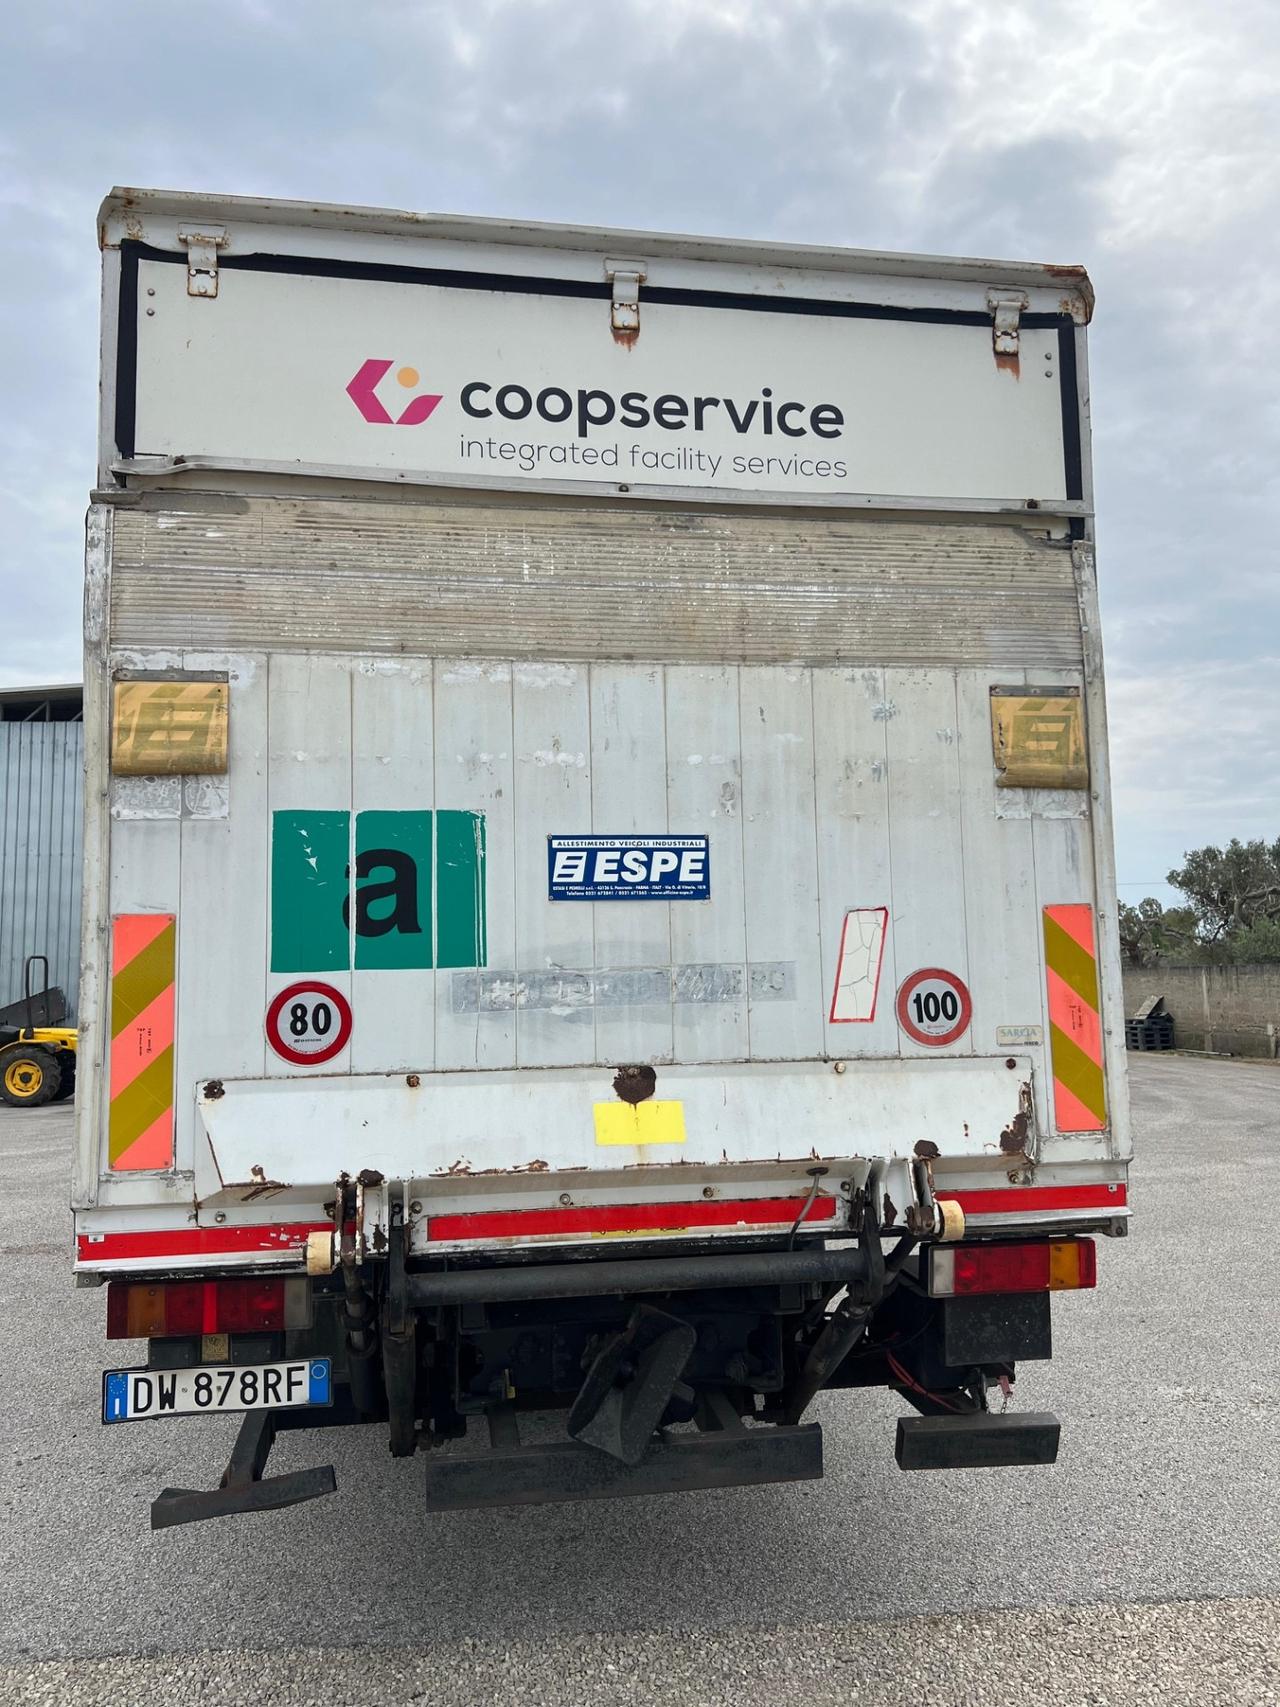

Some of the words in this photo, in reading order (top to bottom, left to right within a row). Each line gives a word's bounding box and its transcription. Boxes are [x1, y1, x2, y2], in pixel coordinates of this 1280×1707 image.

[460, 381, 844, 438] coopservice
[460, 434, 618, 471] integrated
[629, 444, 722, 477] facility
[733, 453, 847, 478] services
[593, 850, 705, 882] ESPE
[342, 848, 422, 937] a
[290, 1003, 331, 1036] 80
[913, 990, 958, 1023] 100
[133, 1373, 177, 1413] DW
[194, 1365, 305, 1407] 878RF
